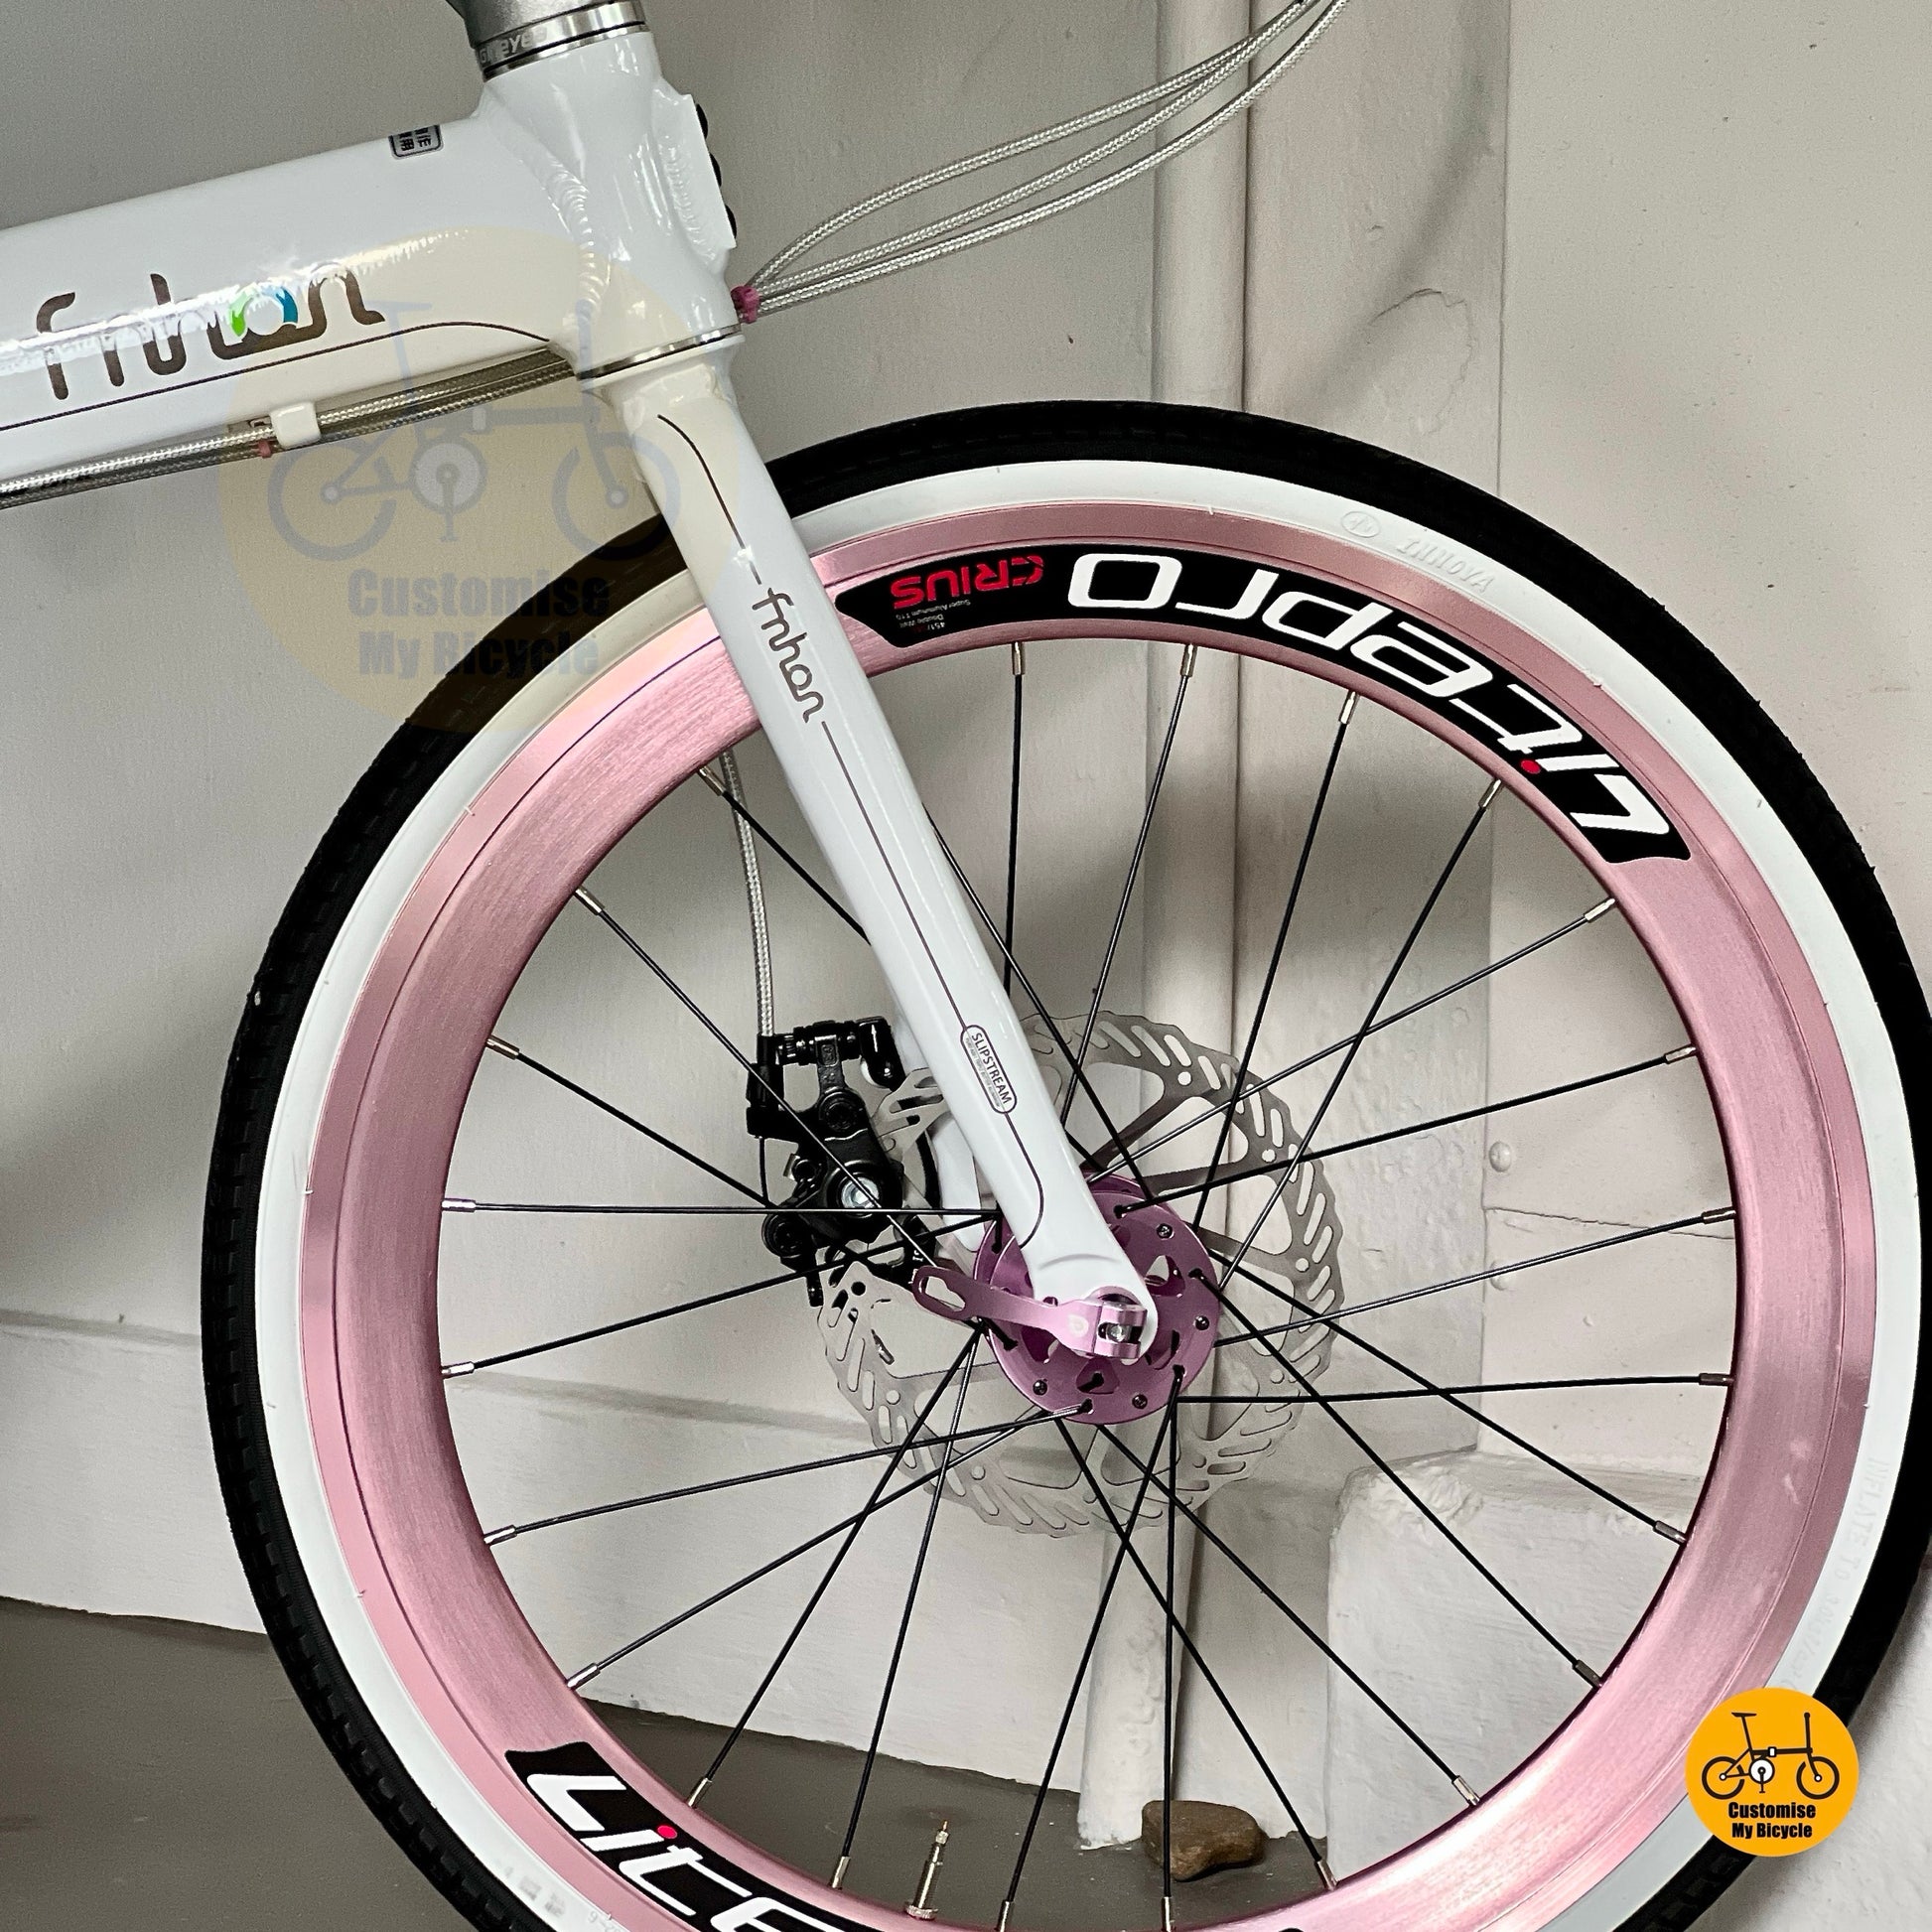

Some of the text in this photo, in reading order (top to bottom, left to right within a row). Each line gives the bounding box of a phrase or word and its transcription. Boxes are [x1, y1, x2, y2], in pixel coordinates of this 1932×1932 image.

[891, 555, 1044, 610] CRIUS
[752, 587, 824, 723] fnhon
[972, 1033, 1013, 1104] SLIPSTREAM
